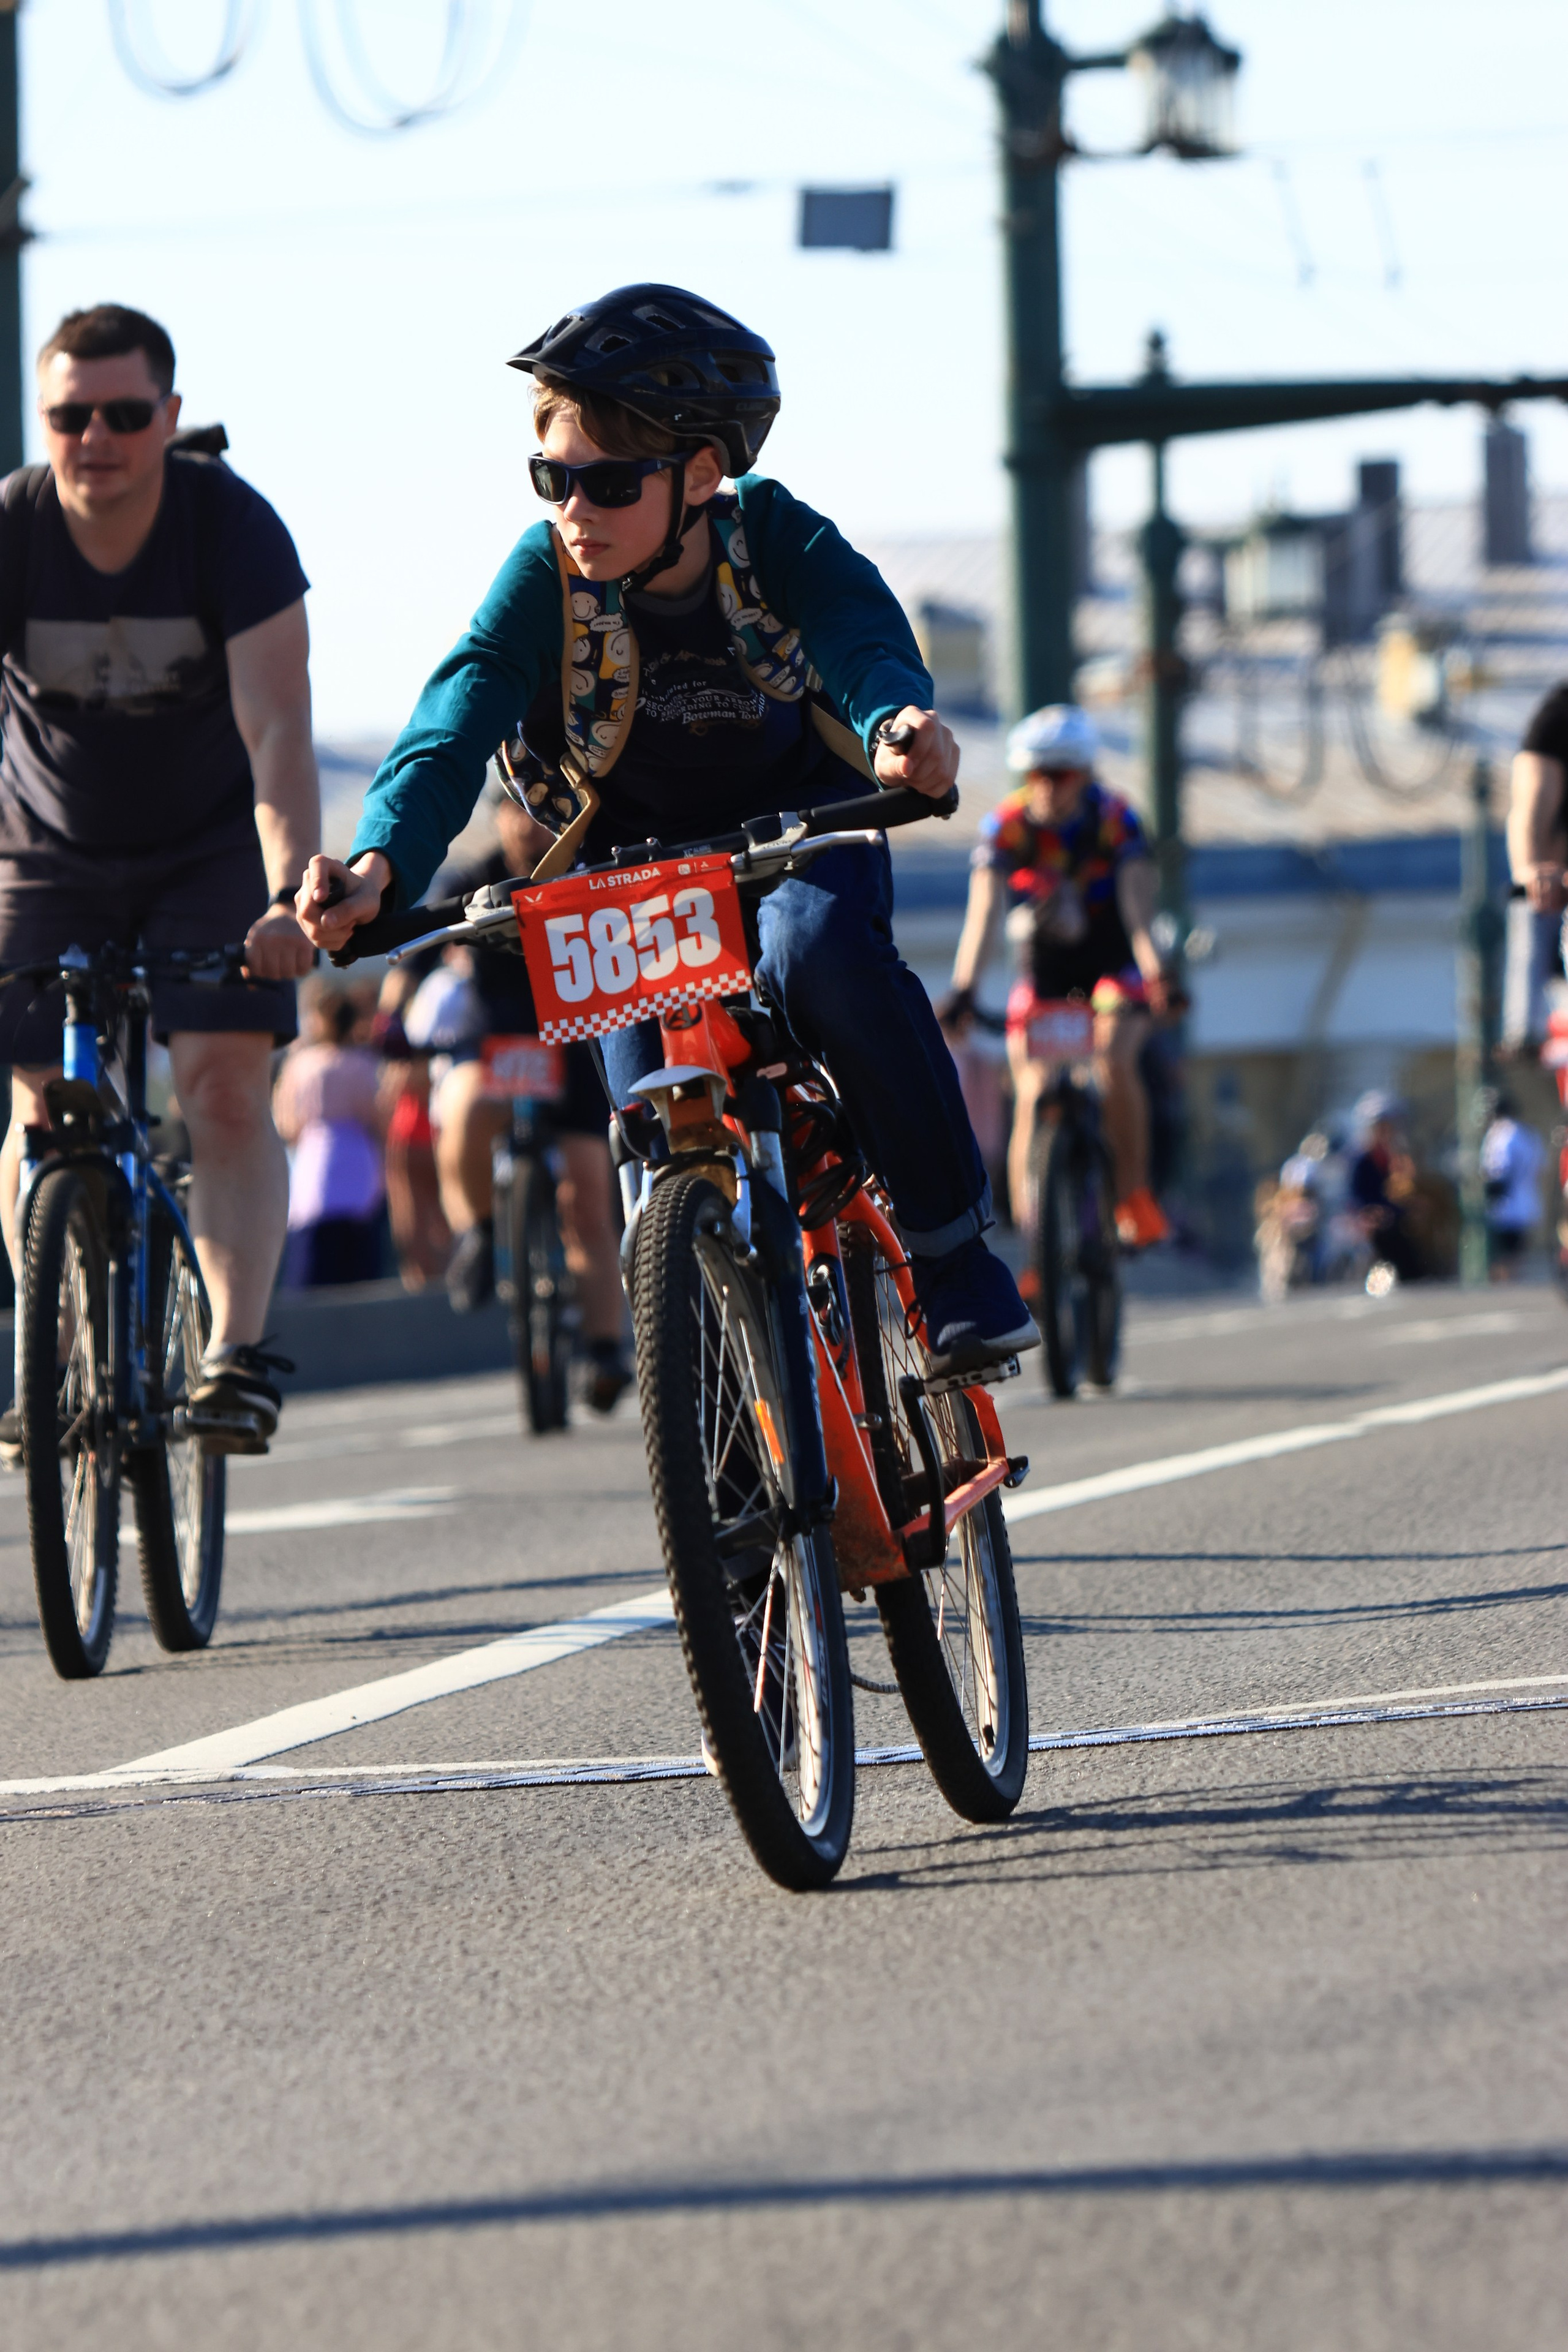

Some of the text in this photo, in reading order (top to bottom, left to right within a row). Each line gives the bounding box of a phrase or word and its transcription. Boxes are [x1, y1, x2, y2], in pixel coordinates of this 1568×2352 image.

[646, 707, 657, 718] TO
[692, 695, 719, 704] YOUR
[682, 710, 736, 725] Bowman
[589, 878, 606, 890] LA
[607, 867, 661, 887] STRADA
[545, 888, 722, 1003] 5853
